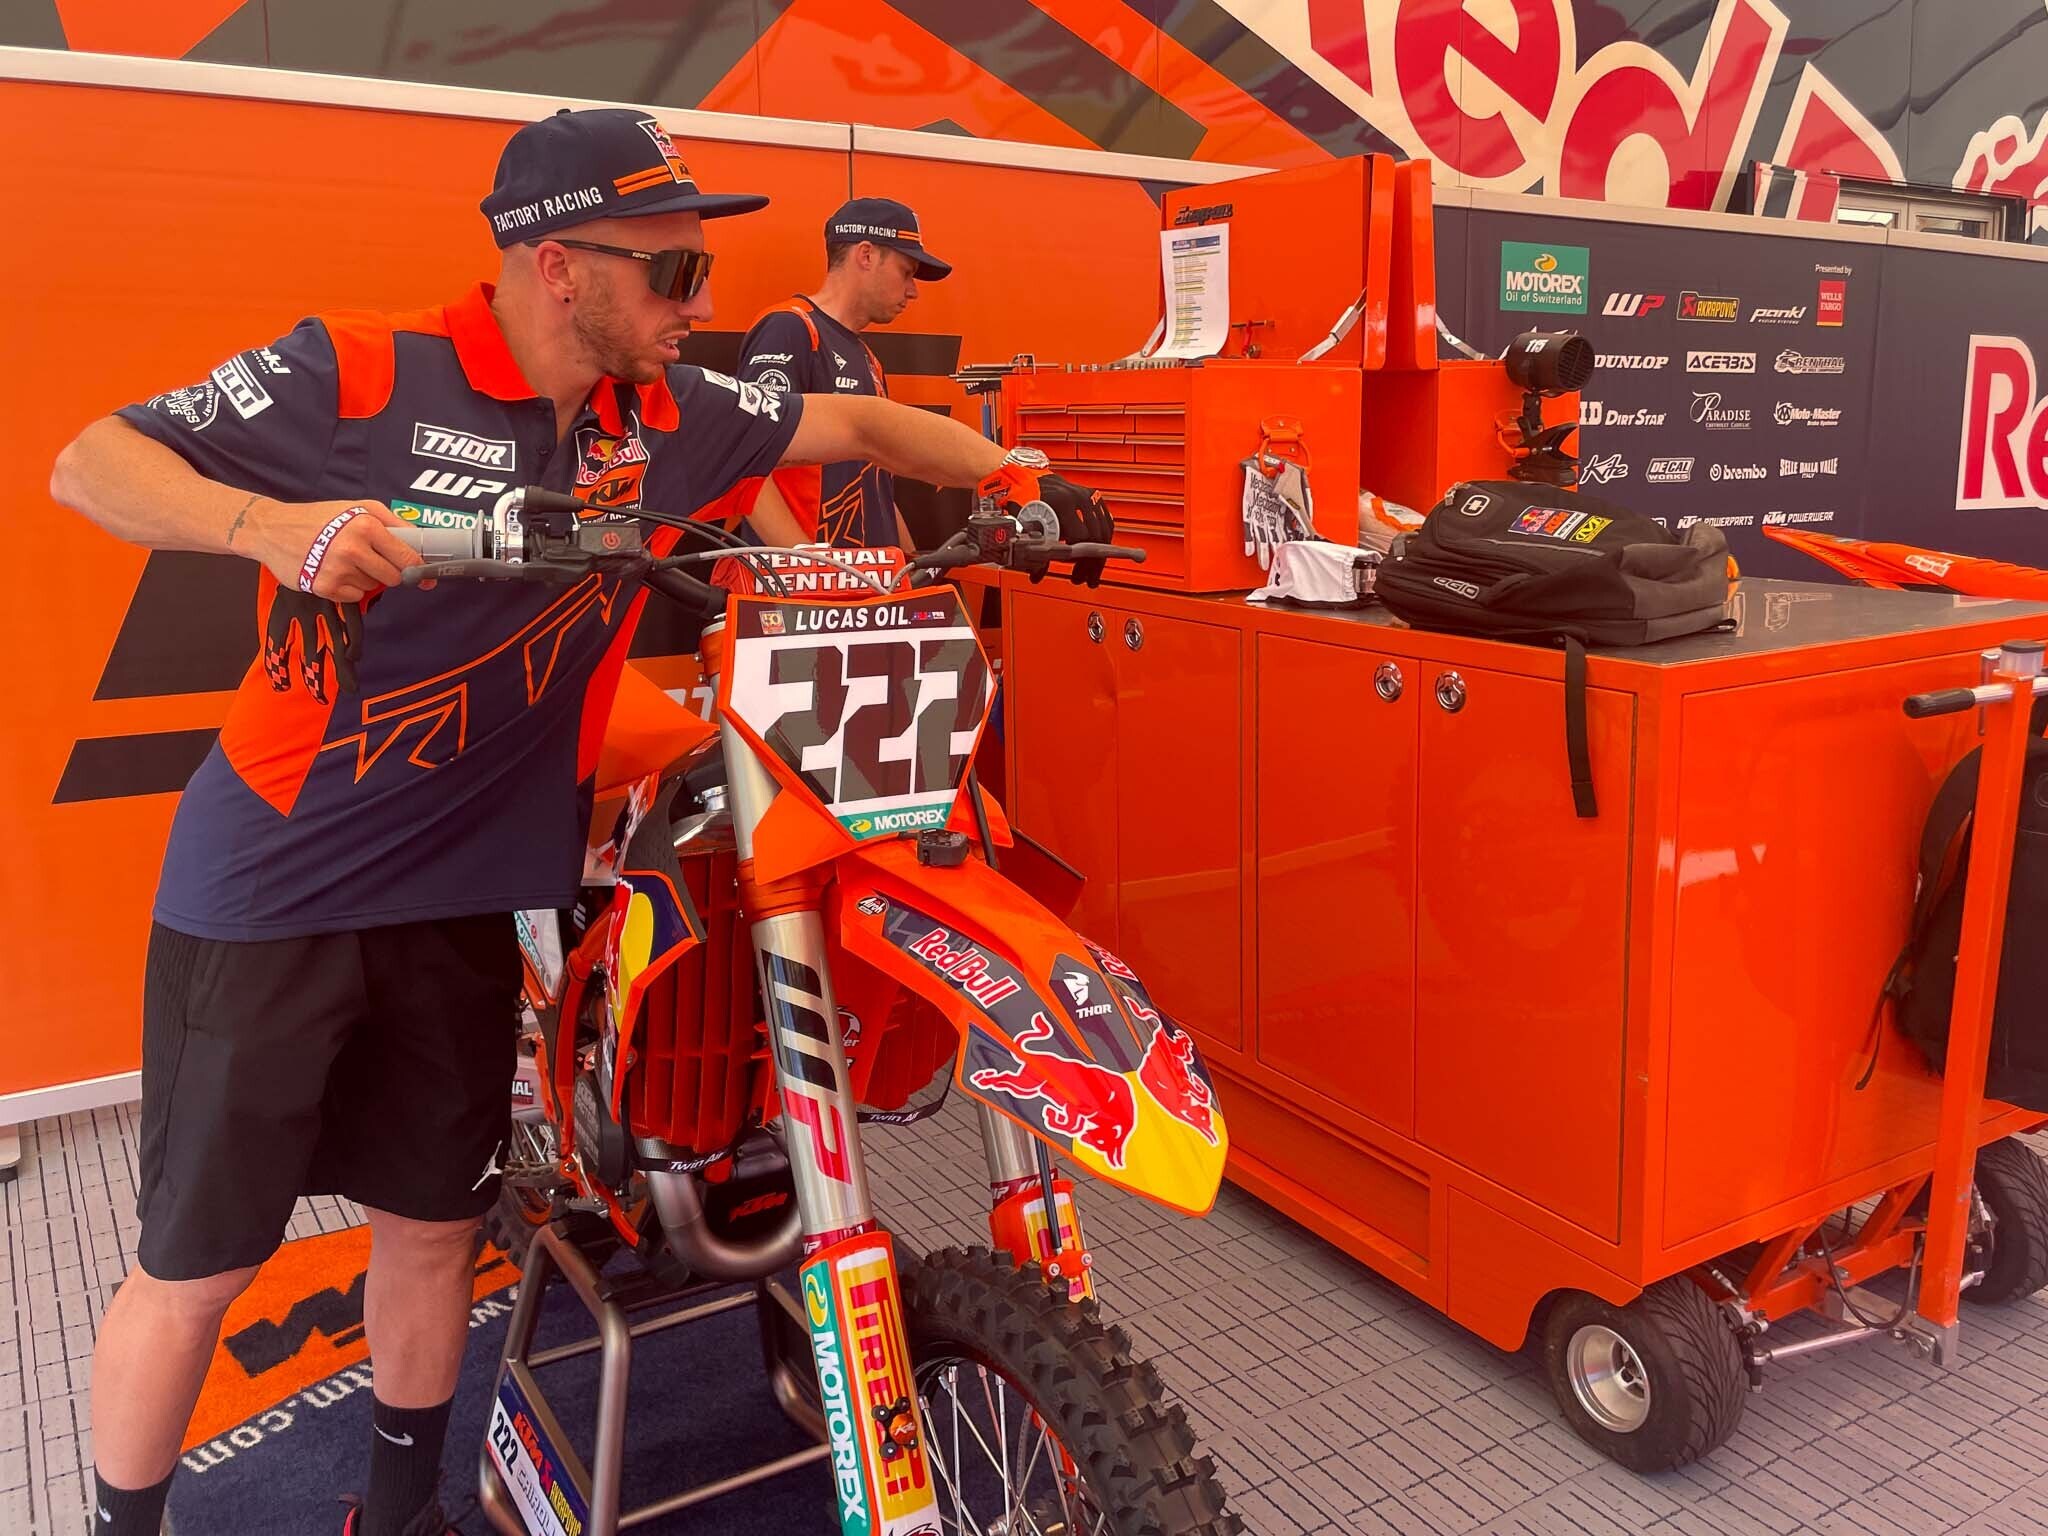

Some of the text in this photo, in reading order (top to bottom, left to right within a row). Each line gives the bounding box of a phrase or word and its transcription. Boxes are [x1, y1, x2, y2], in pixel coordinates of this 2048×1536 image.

[494, 187, 603, 233] FACTORY RACING
[835, 224, 896, 238] FACTORY RACING
[1815, 264, 1852, 276] Presented by
[1506, 270, 1582, 295] MOTOREX
[1506, 291, 1582, 306] Oil of Switzerland
[1602, 293, 1666, 317] WP
[1821, 292, 1842, 301] WELLS
[1750, 306, 1807, 323] pankl
[1821, 302, 1842, 311] FARGO
[1594, 354, 1669, 369] DUNLOP
[1796, 357, 1845, 367] RENTHAL
[835, 377, 858, 389] WP
[423, 430, 507, 466] THOR
[1723, 464, 1767, 480] brembo
[1780, 457, 1838, 477] SELLE DALLA VALLE
[410, 469, 507, 499] WP
[1704, 516, 1754, 527] POWERPARTS
[1763, 511, 1834, 526] KTM POWERWEAR
[304, 512, 353, 578] RACEWAY
[755, 570, 901, 593] RENTHAL
[796, 607, 868, 631] LUCAS
[764, 638, 987, 804] 222
[875, 808, 945, 831] MOTOREX
[1076, 1004, 1112, 1019] THOR
[870, 1113, 901, 1122] Twin
[670, 1151, 726, 1171] Twin Air
[813, 1332, 867, 1523] MOTOREX
[493, 1411, 519, 1476] 222
